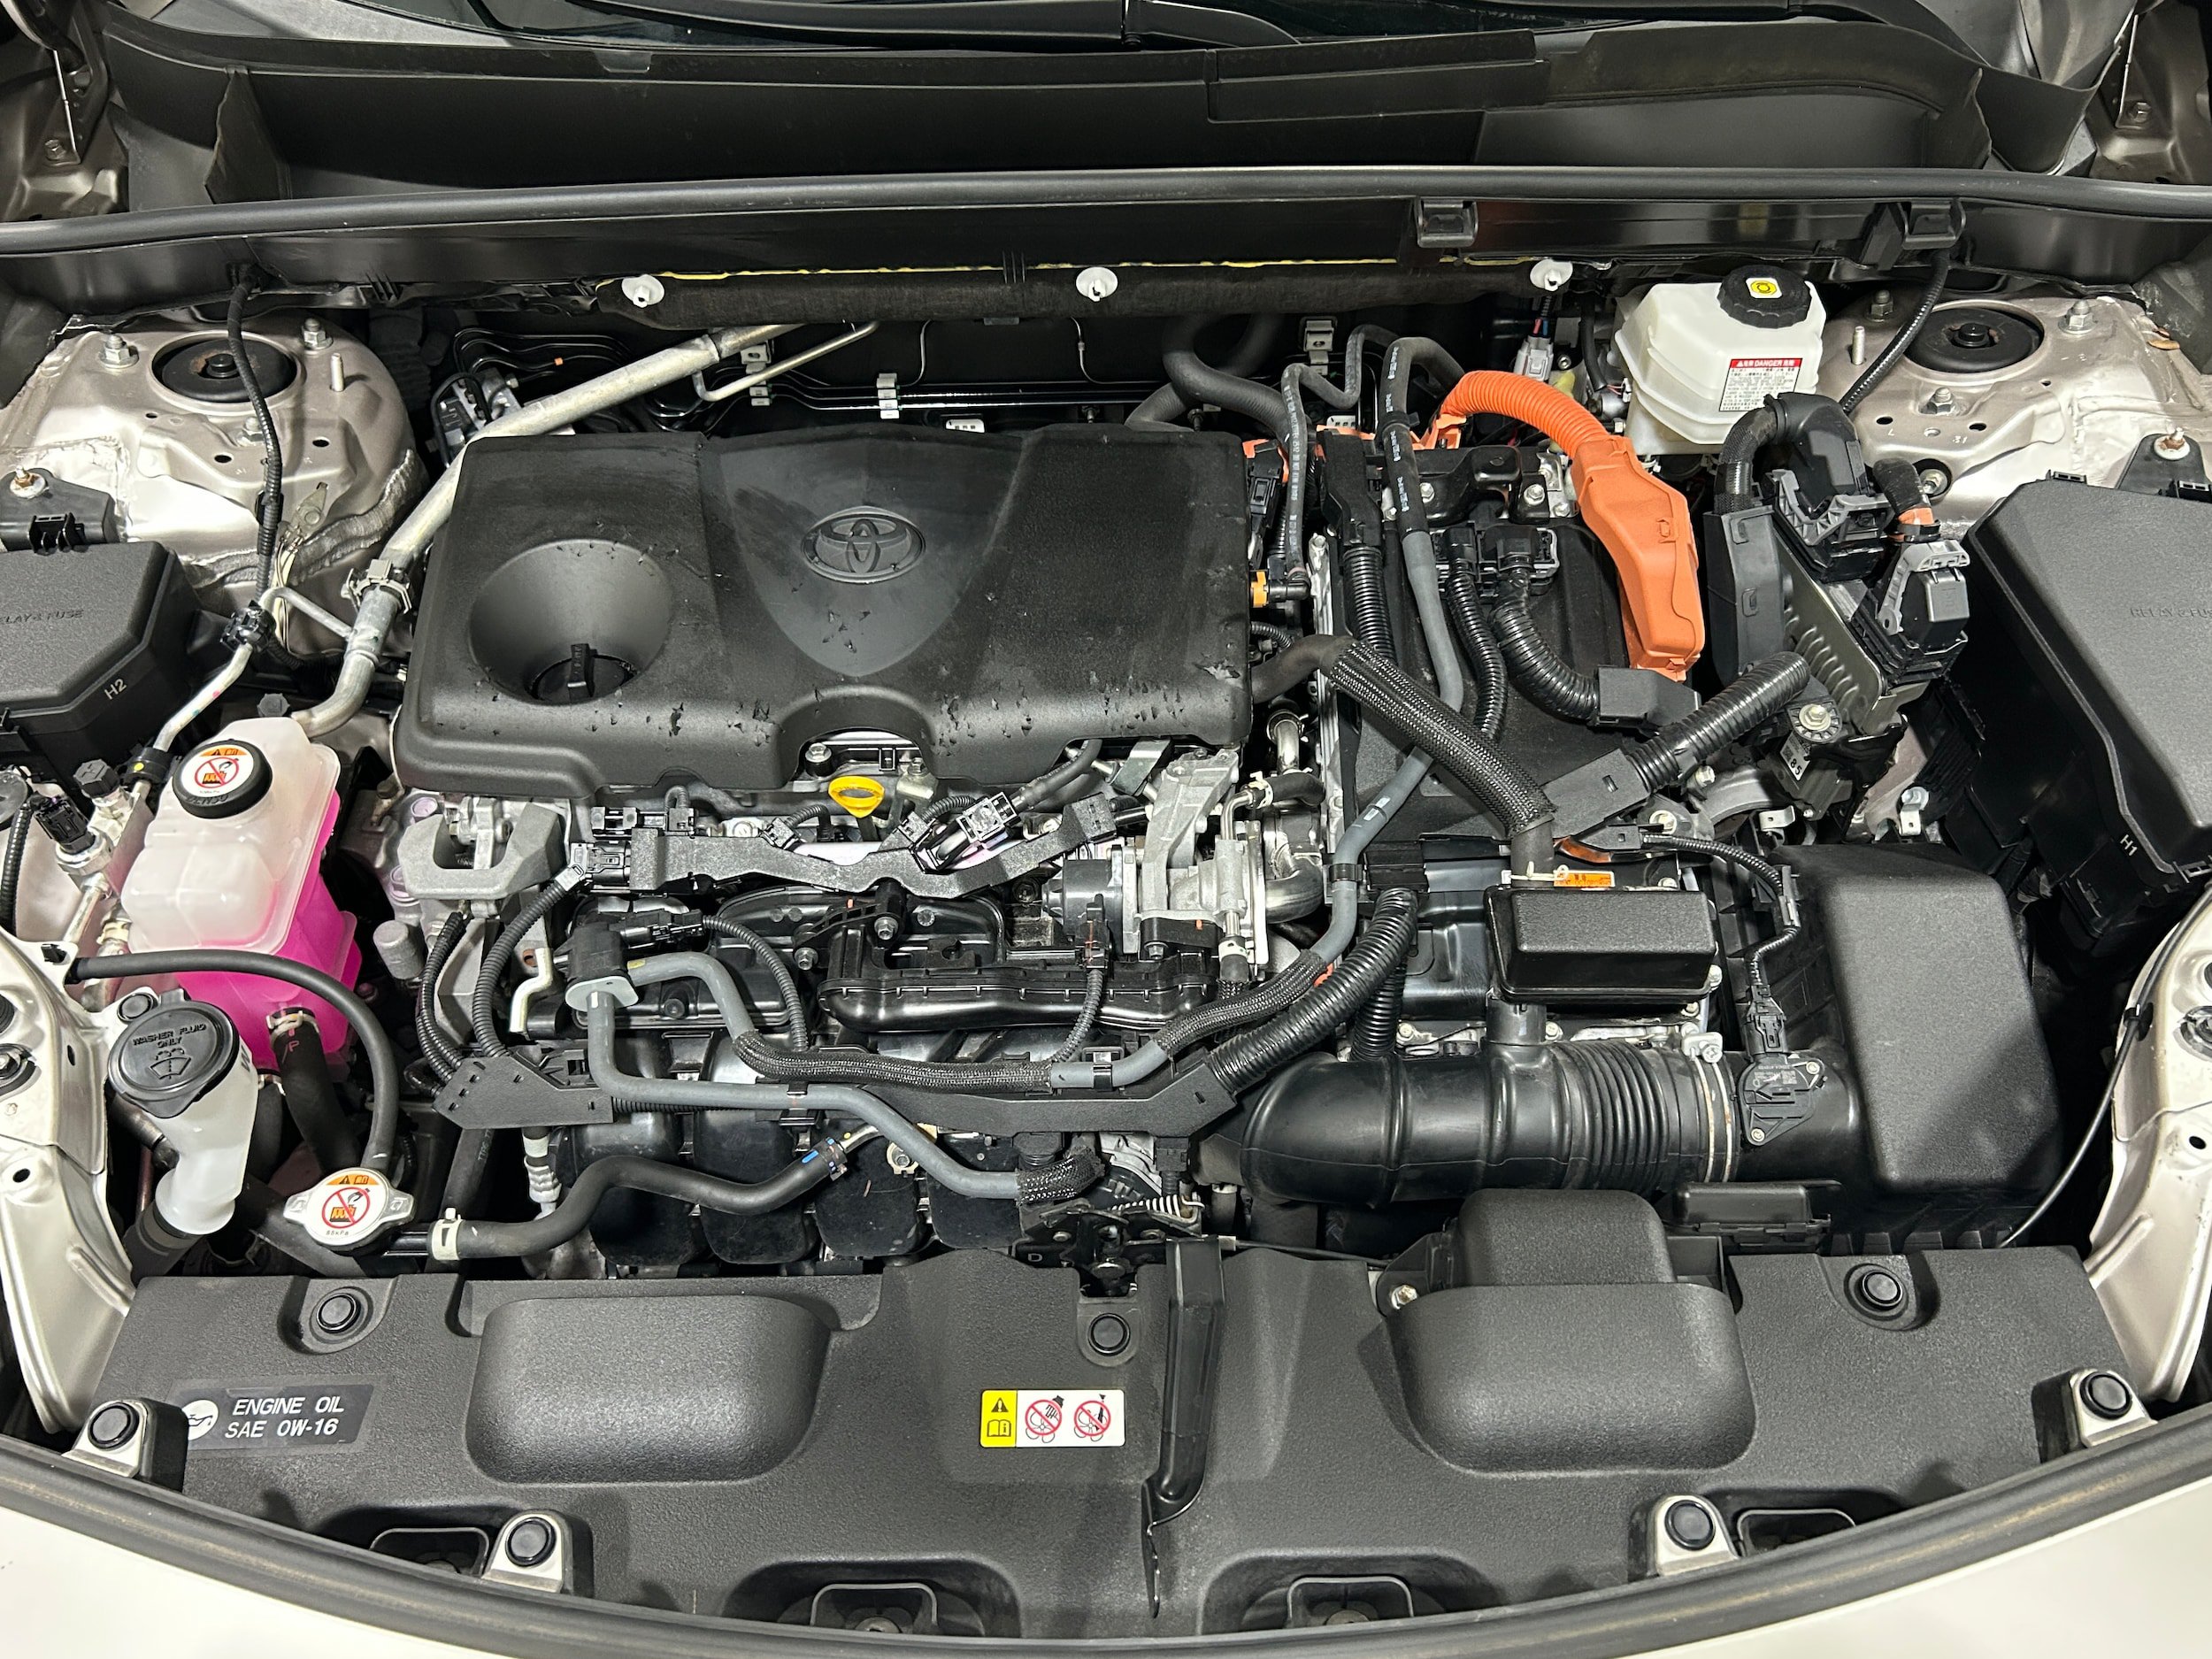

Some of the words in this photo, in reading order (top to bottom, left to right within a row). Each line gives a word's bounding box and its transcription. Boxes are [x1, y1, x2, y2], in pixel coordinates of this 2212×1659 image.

[2130, 608, 2173, 618] RELAY
[104, 679, 127, 700] H2
[1790, 757, 1802, 775] 85
[2120, 834, 2138, 856] H1
[133, 1031, 173, 1046] WASHER
[180, 1024, 207, 1035] FLUID
[157, 1036, 182, 1048] ONLY
[233, 1397, 305, 1416] ENGINE
[314, 1396, 344, 1413] OIL
[225, 1420, 267, 1439] SAE
